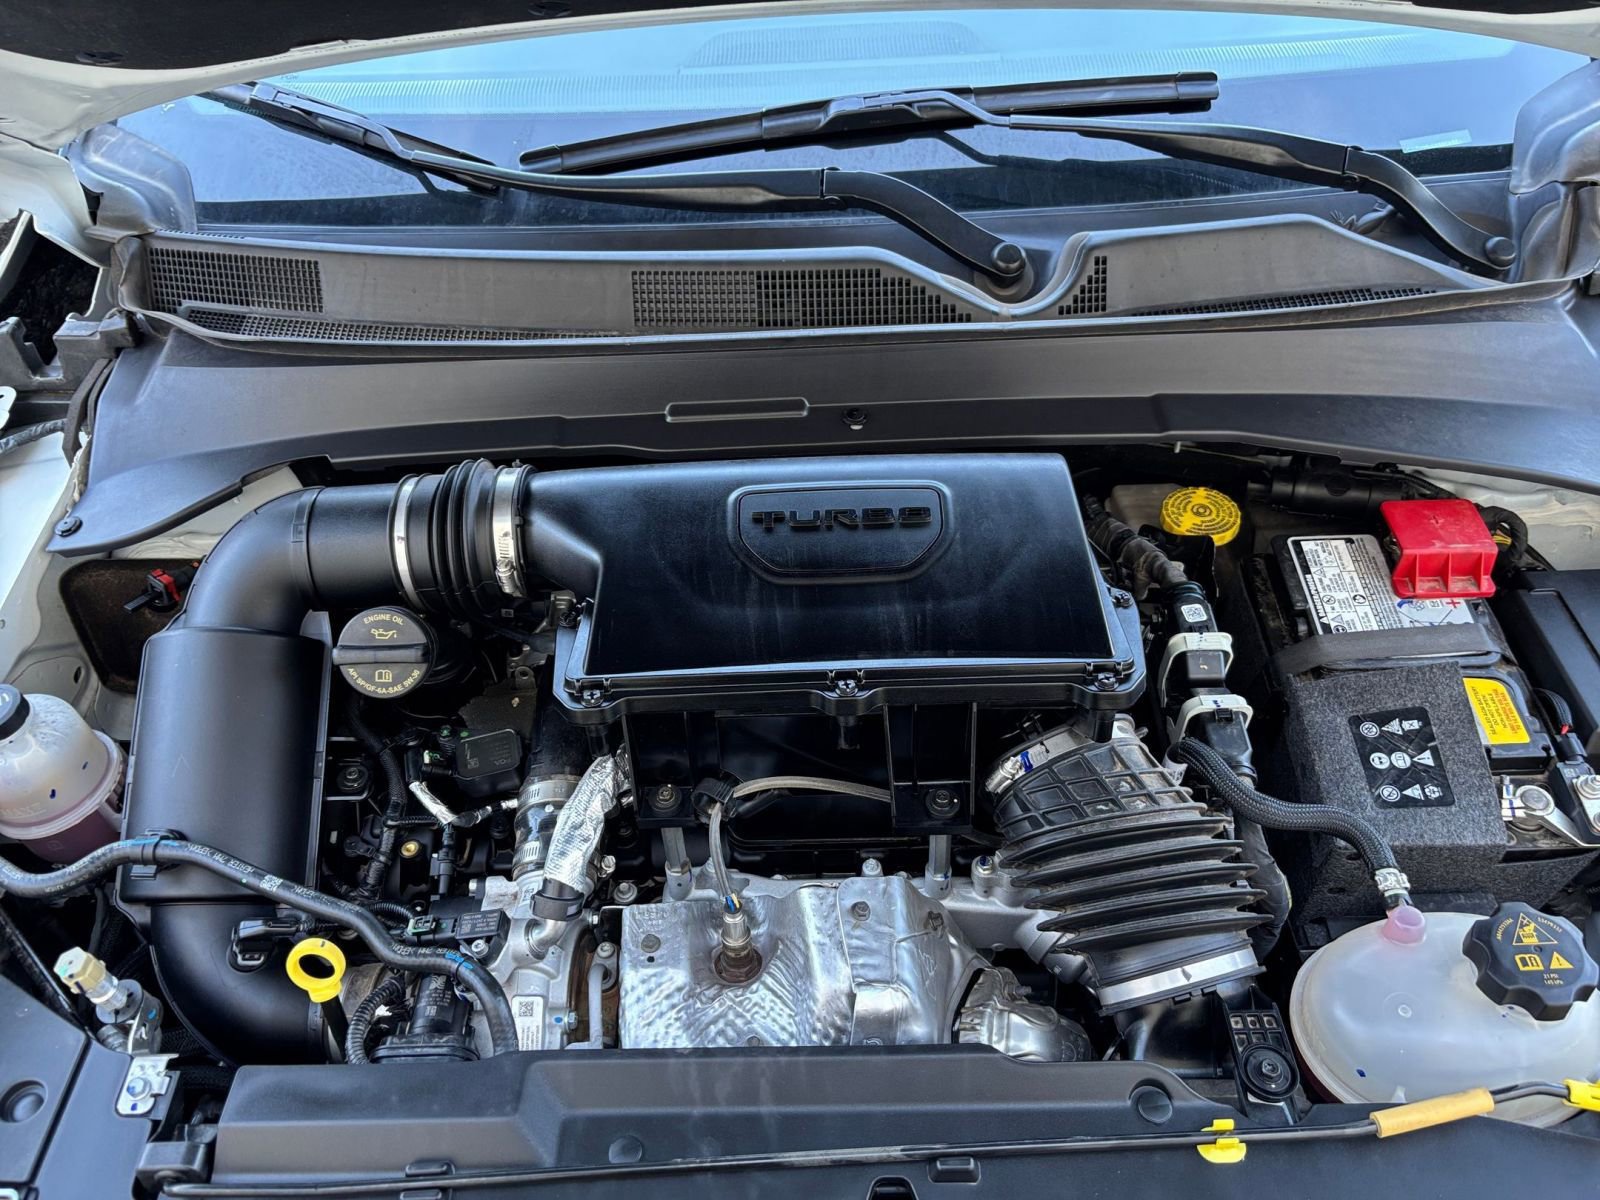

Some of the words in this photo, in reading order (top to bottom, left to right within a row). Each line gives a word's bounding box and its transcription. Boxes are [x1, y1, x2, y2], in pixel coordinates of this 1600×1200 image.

[751, 506, 932, 530] TURBO
[363, 613, 391, 624] ENGINE
[392, 615, 404, 626] OIL
[347, 668, 358, 680] API
[402, 669, 420, 688] 5W-30
[227, 858, 254, 875] HEATER
